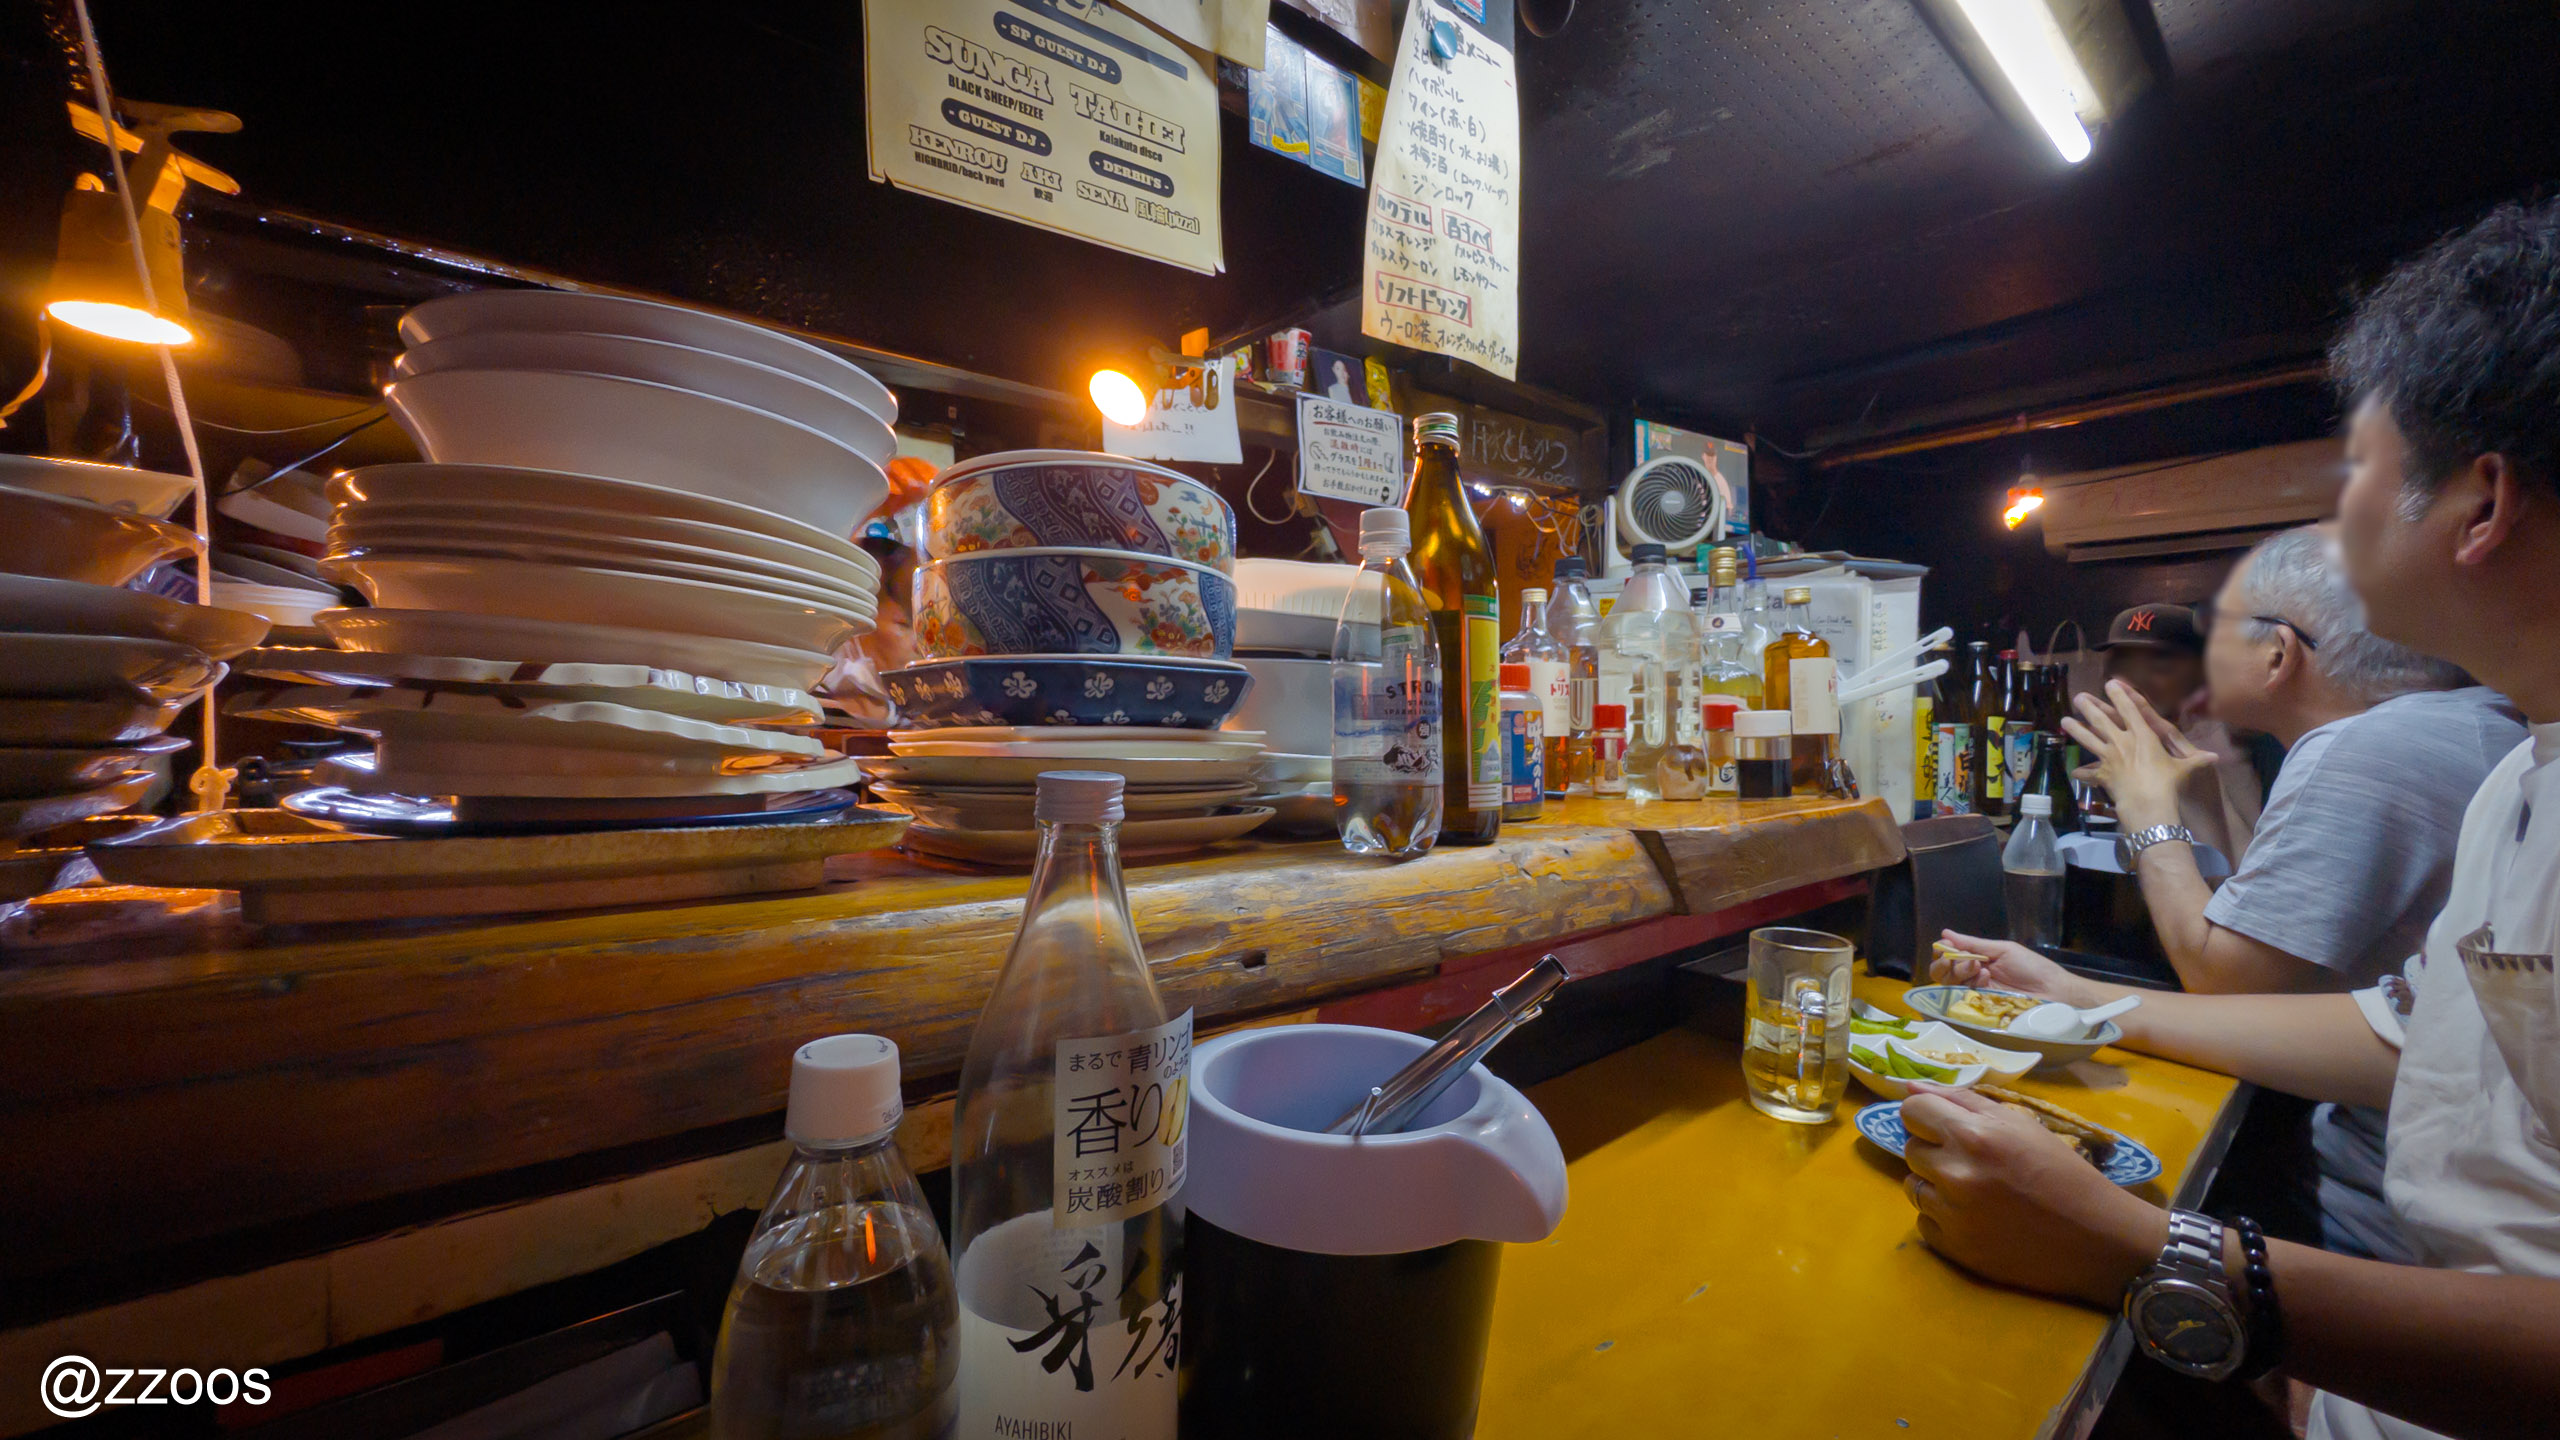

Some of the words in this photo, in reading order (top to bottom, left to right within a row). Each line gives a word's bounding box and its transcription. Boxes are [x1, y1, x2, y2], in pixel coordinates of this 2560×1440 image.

[924, 25, 1054, 105] SUNGA
[1010, 24, 1032, 41] SP
[1034, 34, 1085, 64] GUEST
[1086, 56, 1107, 74] DJ
[948, 74, 982, 98] BLACK
[984, 87, 1044, 121] SHEEP/EEZEE
[1409, 67, 1465, 103] ハイボール
[958, 110, 1012, 138] GUEST
[1015, 129, 1037, 146] DJ
[909, 124, 1008, 174] KENROU
[1100, 130, 1139, 154] Kalakuta
[1139, 145, 1163, 163] disco
[985, 175, 1005, 188] yard
[1020, 162, 1062, 192] AKI
[1412, 174, 1474, 210] ジンロック
[1076, 180, 1129, 213] SENA
[1377, 193, 1432, 226] カクテル
[1446, 214, 1492, 253] 酎ハイ
[1453, 266, 1499, 290] レモンサワー
[1377, 279, 1469, 321] ソフトドリンク
[1313, 404, 1393, 433] お客様へのお願い
[2127, 610, 2155, 631] NY
[1066, 1082, 1163, 1159] 香り
[1068, 1160, 1135, 1182] オススメは
[1066, 1167, 1165, 1214] 炭酸割り
[995, 1415, 1073, 1440] AYAHIBIKI
